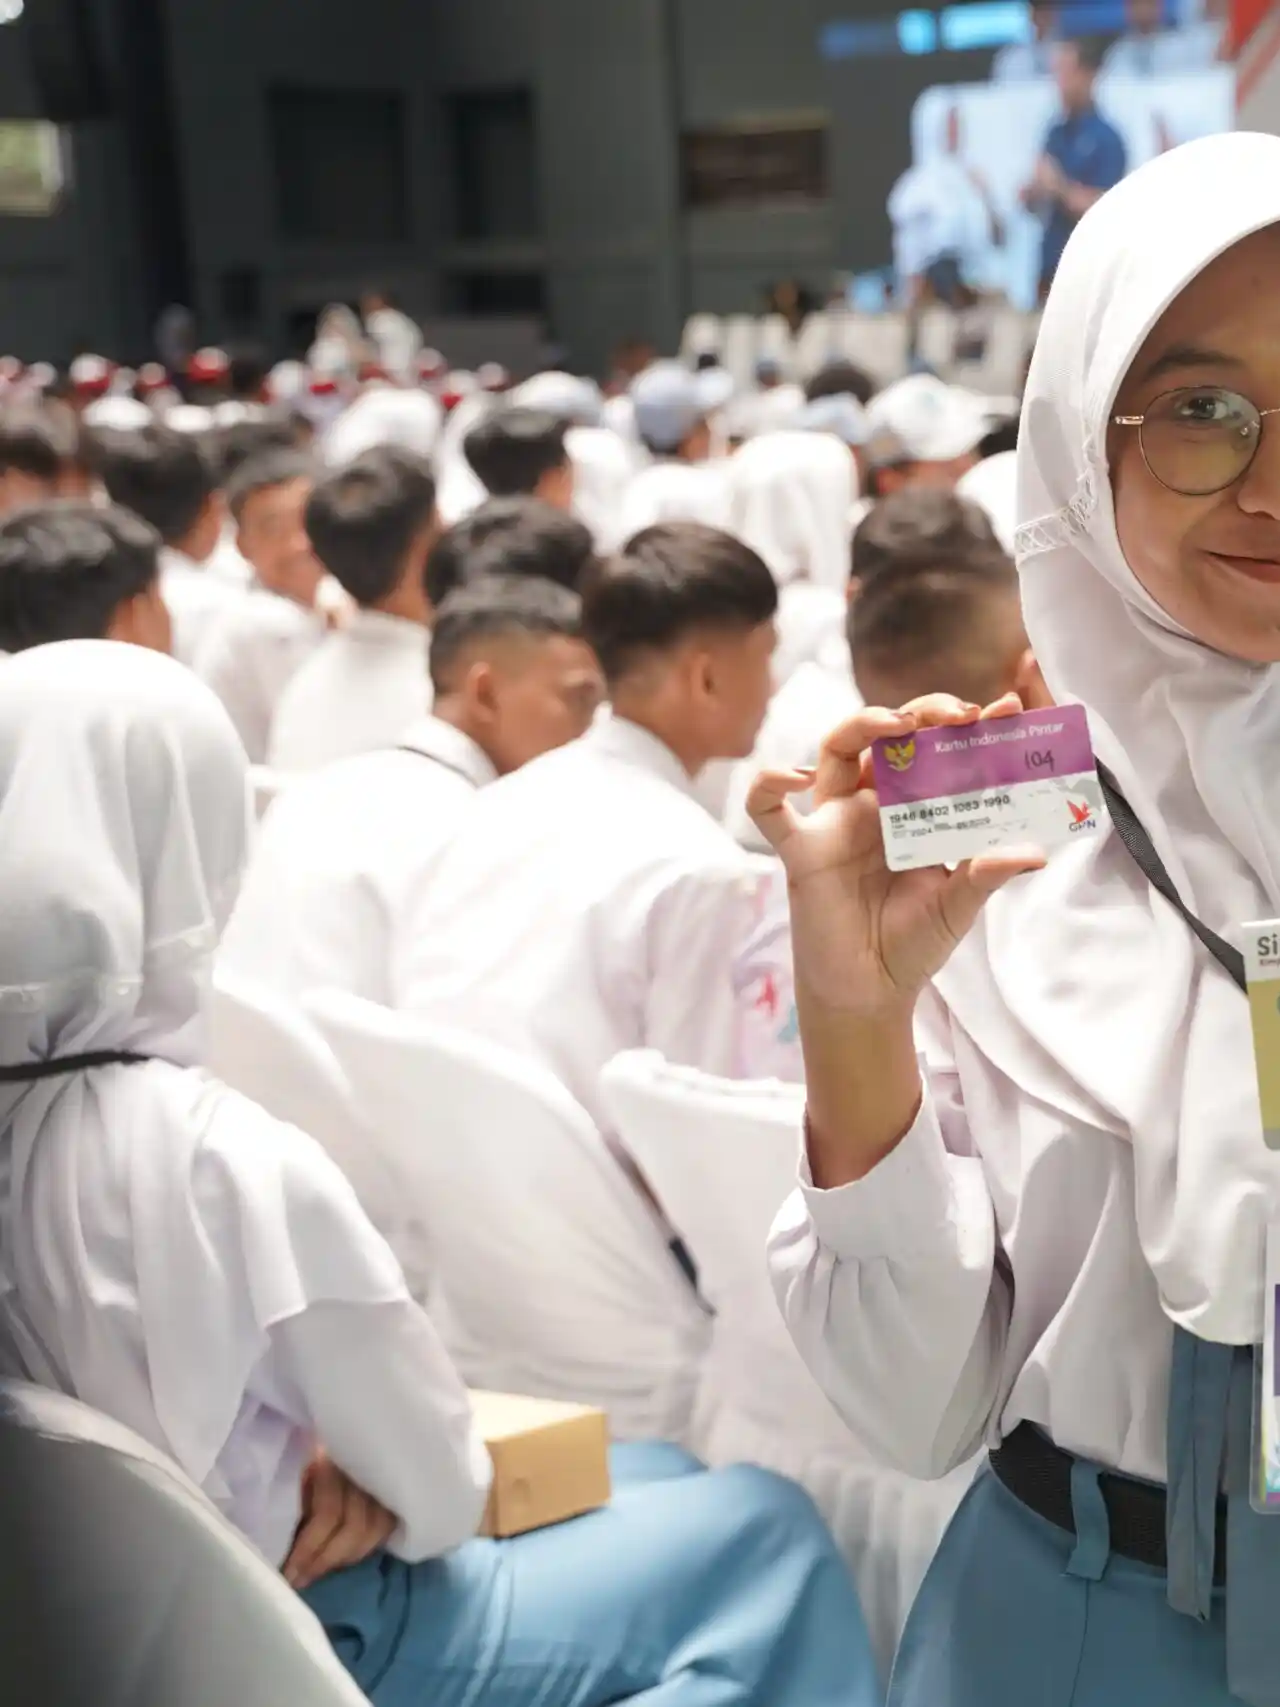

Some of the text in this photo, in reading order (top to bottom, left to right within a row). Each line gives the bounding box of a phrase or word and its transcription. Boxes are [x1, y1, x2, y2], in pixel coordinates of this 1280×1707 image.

[934, 722, 1065, 754] Kartu Indonesia Pintar
[1024, 749, 1056, 773] 104
